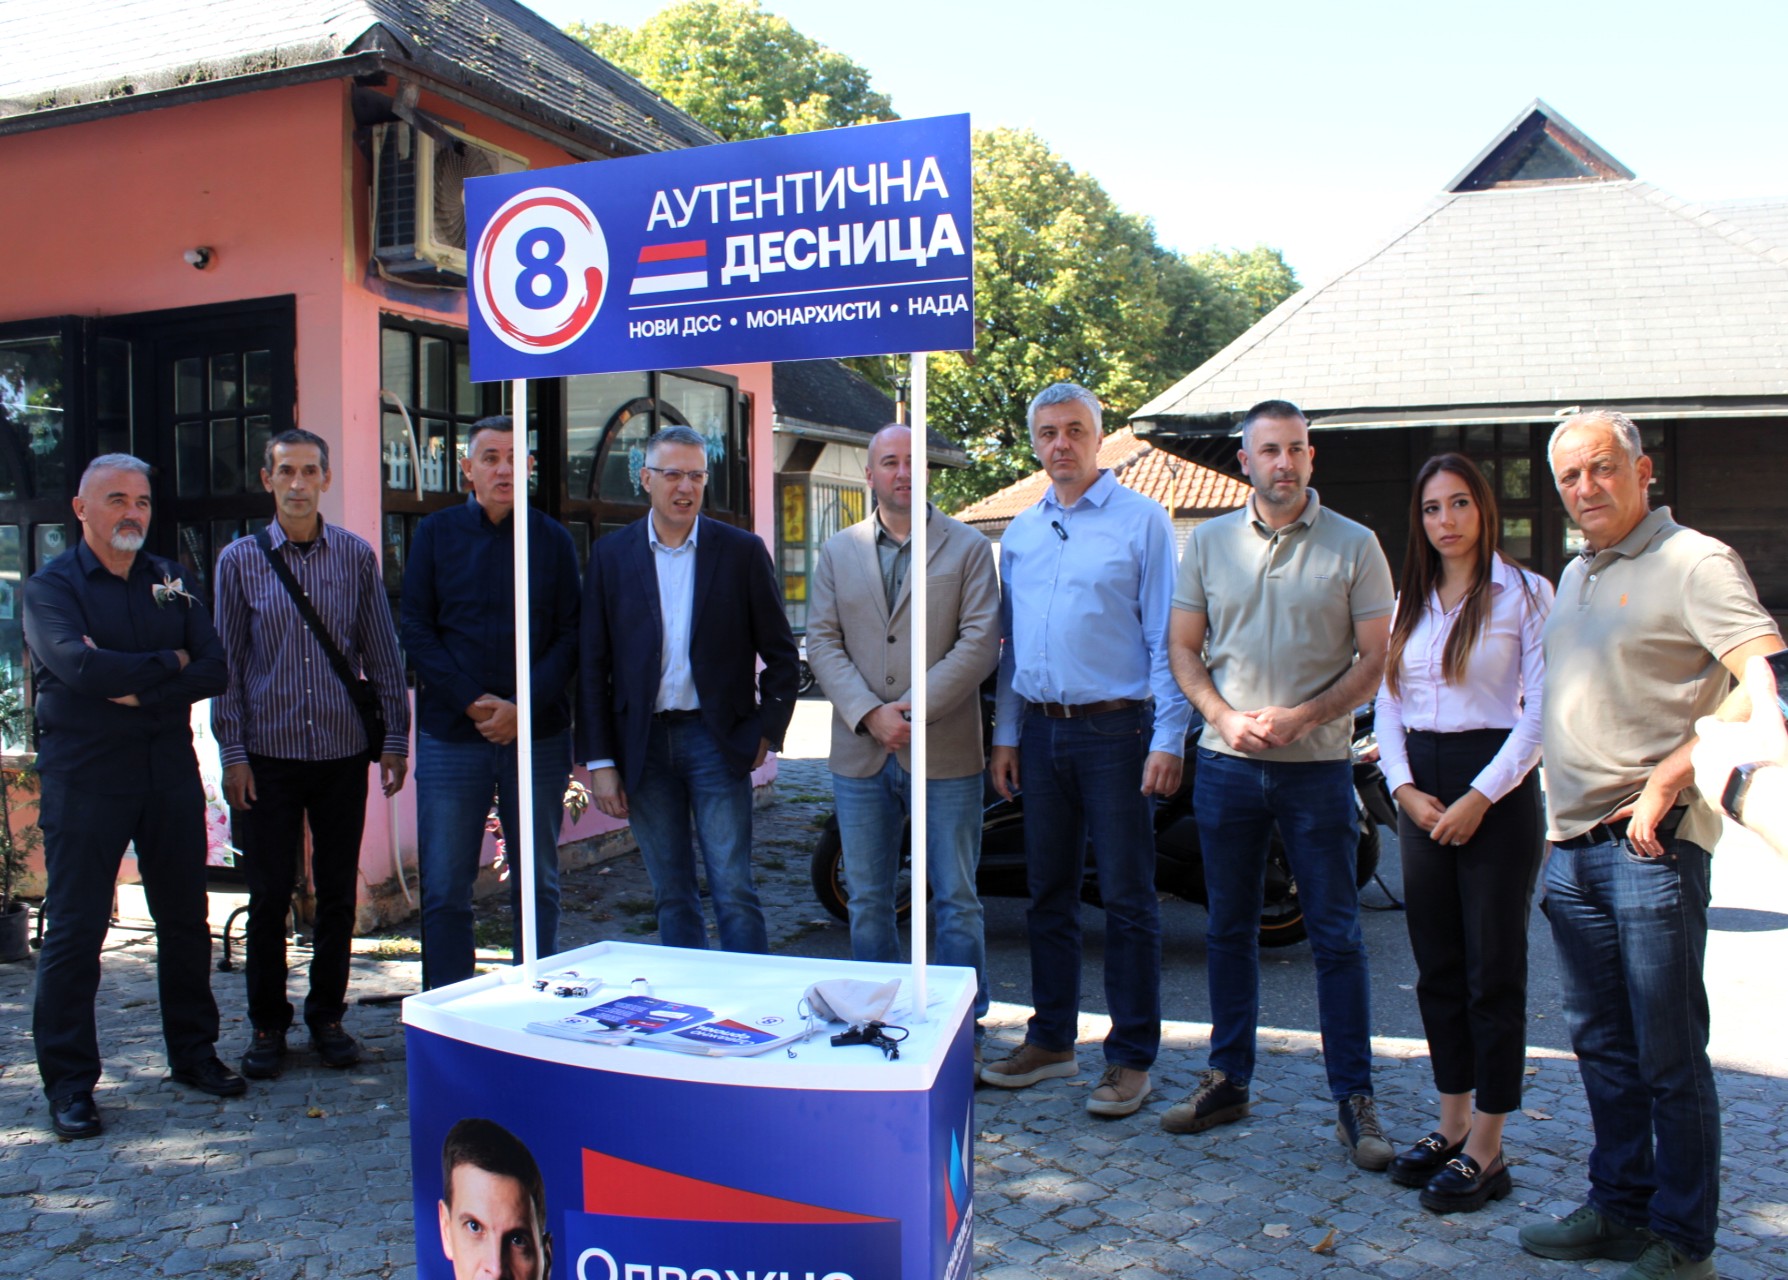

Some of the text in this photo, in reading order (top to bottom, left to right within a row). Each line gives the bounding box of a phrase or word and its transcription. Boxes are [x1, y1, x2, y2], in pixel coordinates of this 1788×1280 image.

[646, 156, 949, 231] АУТЕНТИЧНА
[515, 227, 568, 309] 8
[721, 213, 965, 284] ДЕСНИЦА
[630, 294, 968, 338] НОВИ ДСС МОНАРХИСТИ НАДА
